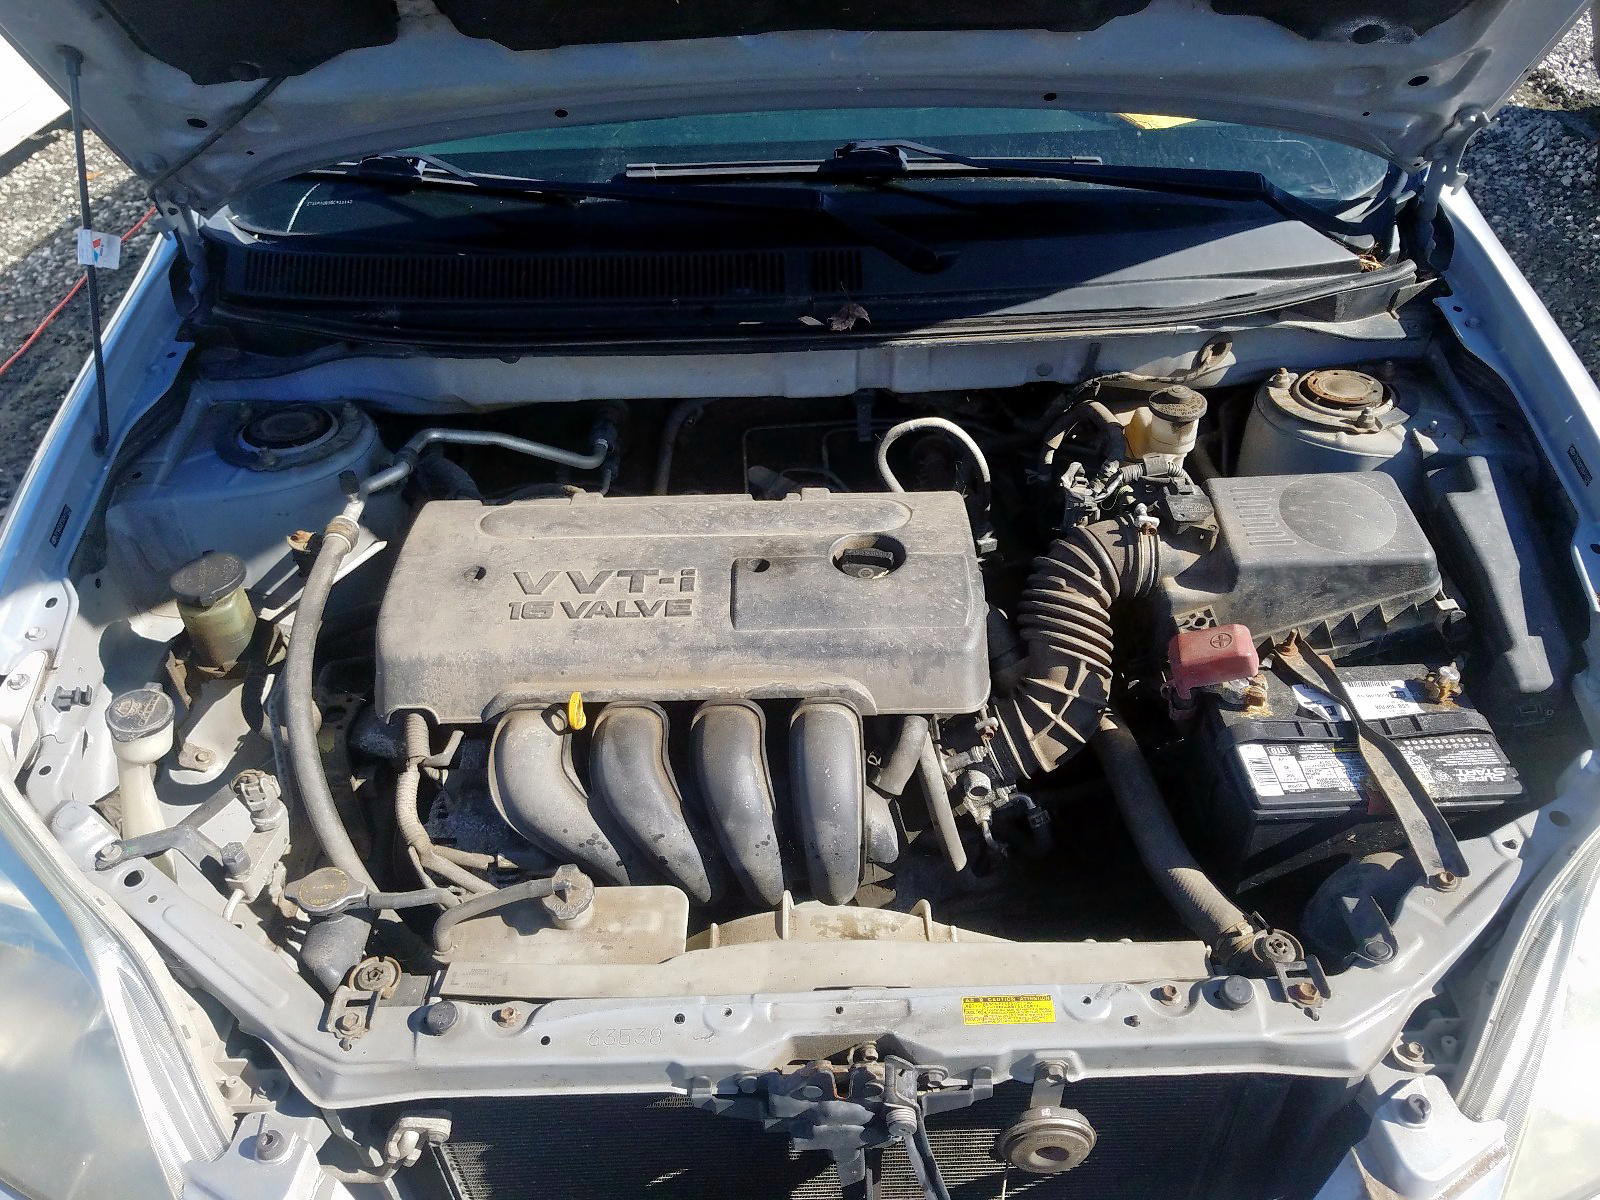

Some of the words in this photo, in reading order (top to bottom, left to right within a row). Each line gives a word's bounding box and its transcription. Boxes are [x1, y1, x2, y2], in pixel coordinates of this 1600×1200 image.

[512, 568, 697, 596] VVT-i
[508, 600, 555, 621] 16
[560, 598, 693, 620] VALVE
[1454, 767, 1507, 778] START
[1458, 774, 1505, 783] SUPER
[587, 1027, 662, 1047] 63538
